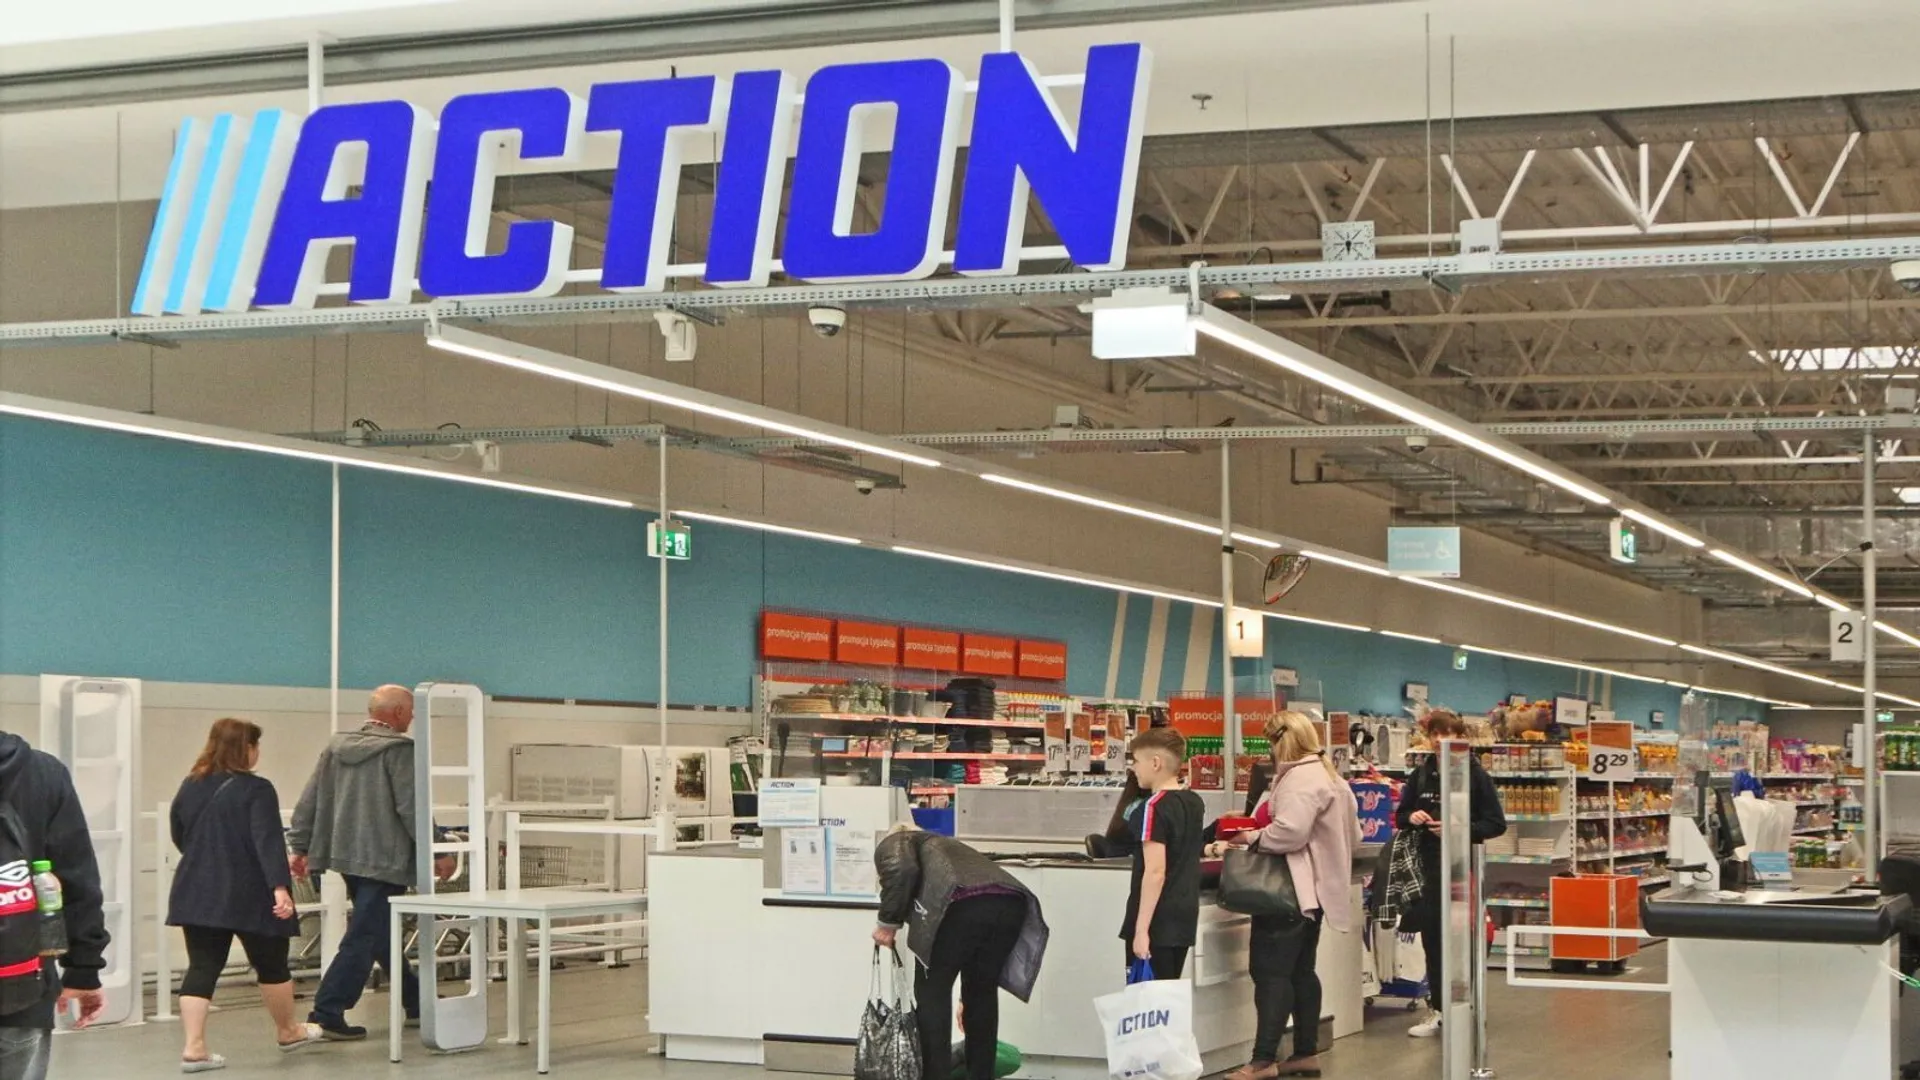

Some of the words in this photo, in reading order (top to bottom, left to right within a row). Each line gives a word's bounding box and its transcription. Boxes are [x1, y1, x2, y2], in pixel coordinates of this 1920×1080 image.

[254, 42, 1153, 310] ACTION
[1236, 620, 1244, 640] 1
[1838, 621, 1853, 643] 2
[1174, 711, 1223, 723] promocja
[819, 817, 846, 827] CTION
